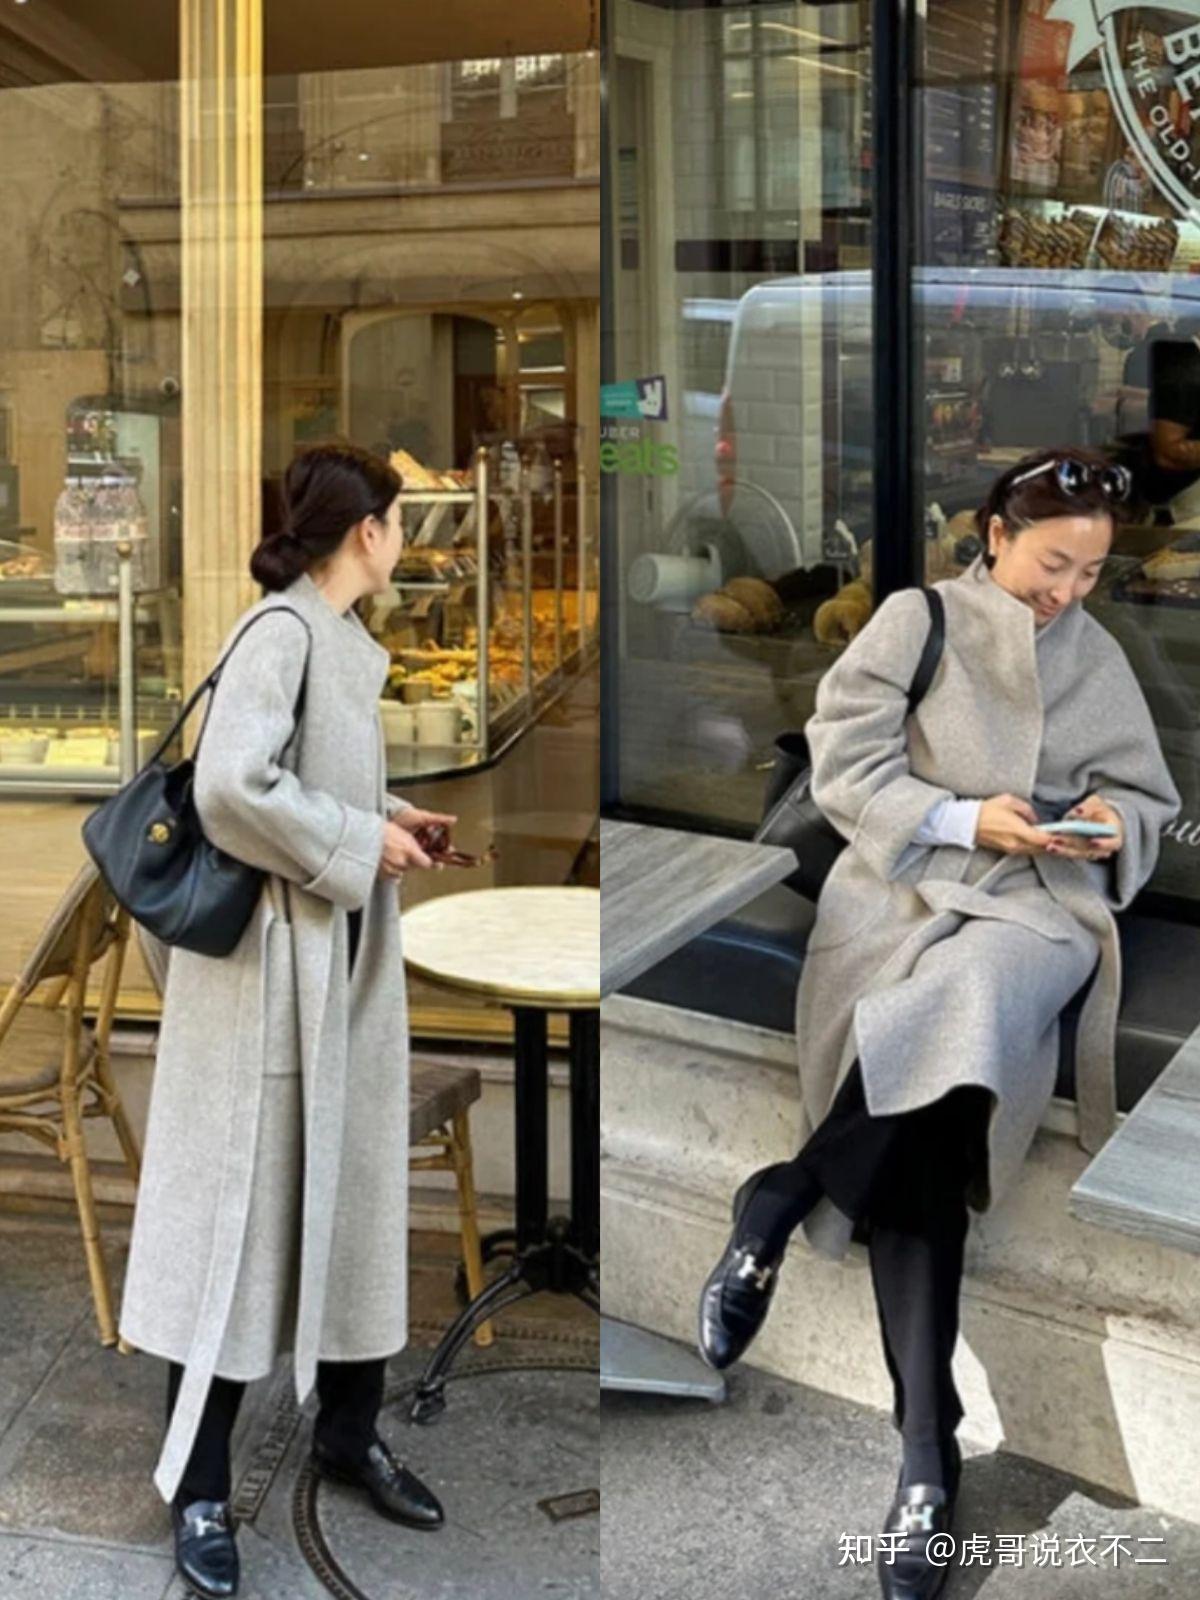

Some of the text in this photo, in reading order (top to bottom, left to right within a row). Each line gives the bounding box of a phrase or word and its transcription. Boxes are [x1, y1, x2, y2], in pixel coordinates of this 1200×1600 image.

[1127, 34, 1200, 181] THE OLD-
[600, 437, 678, 475] eats
